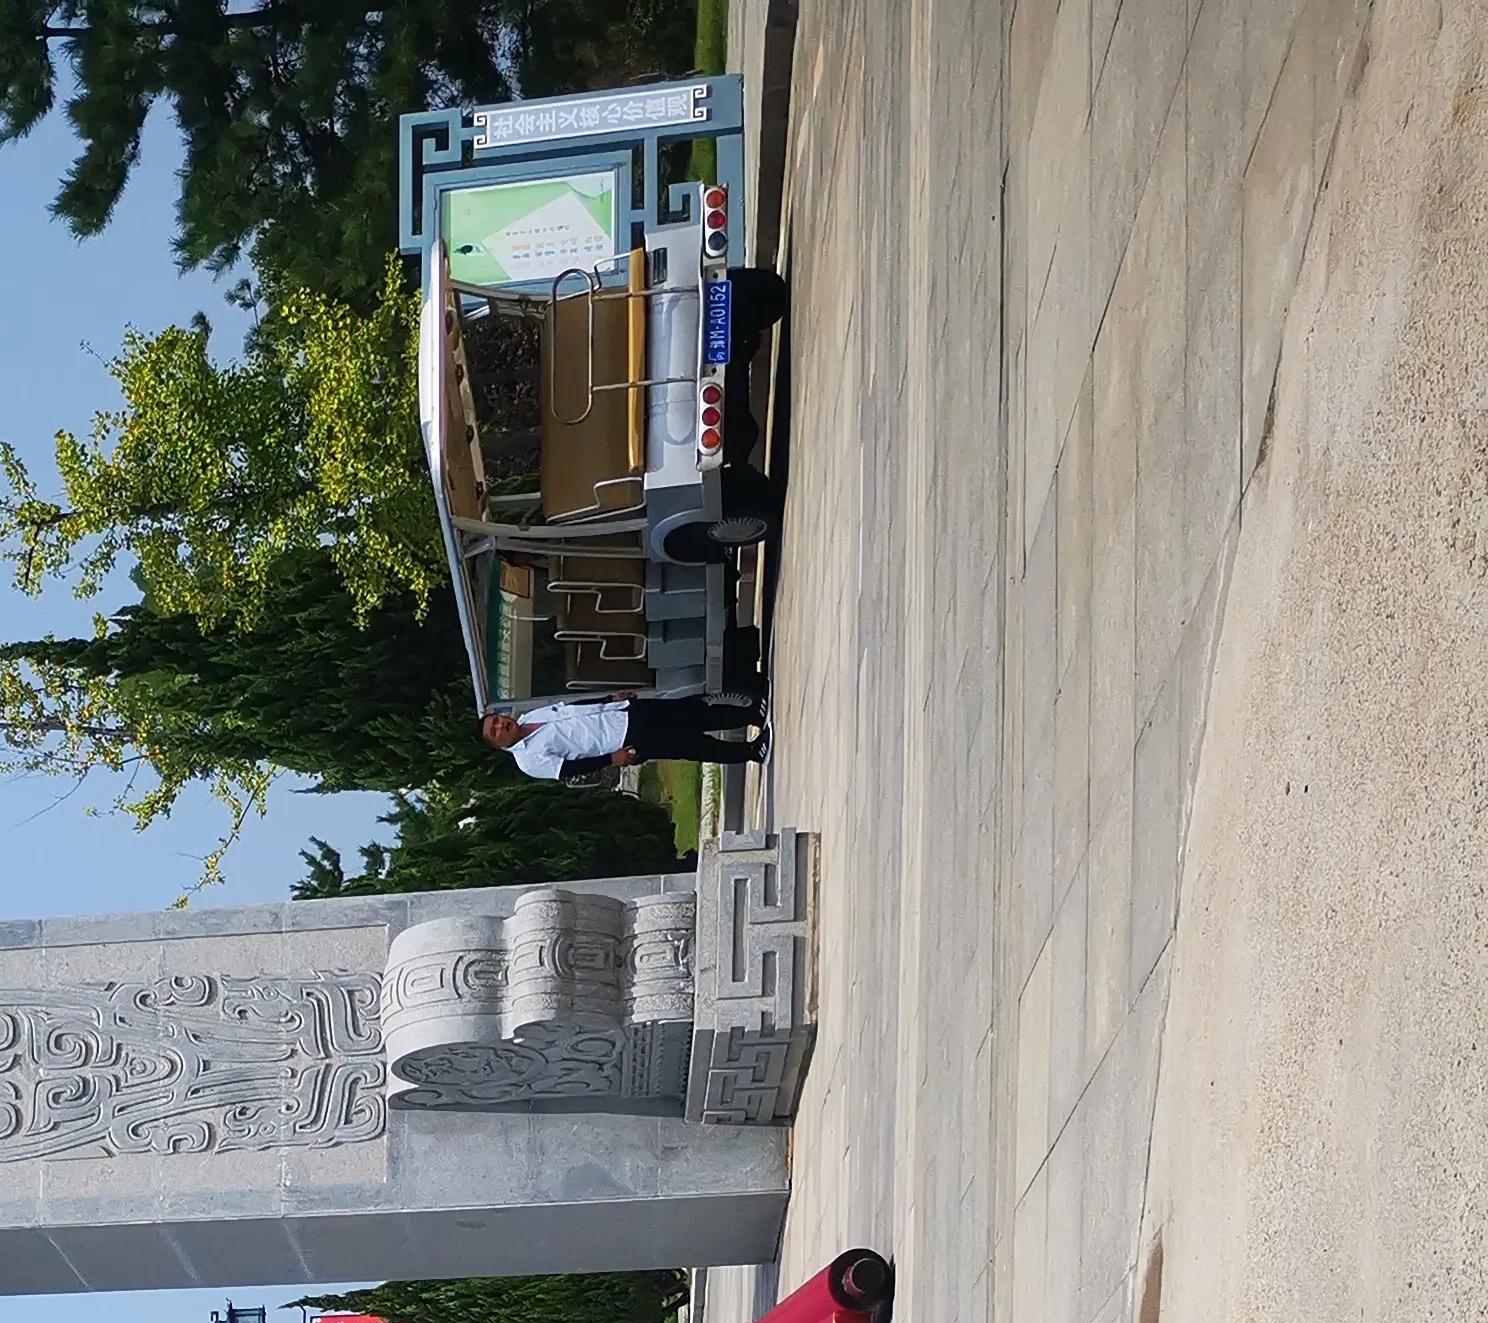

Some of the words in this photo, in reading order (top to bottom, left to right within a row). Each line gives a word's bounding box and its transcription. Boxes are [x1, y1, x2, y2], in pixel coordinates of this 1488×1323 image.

[492, 91, 689, 139] 社会主义核心价值观
